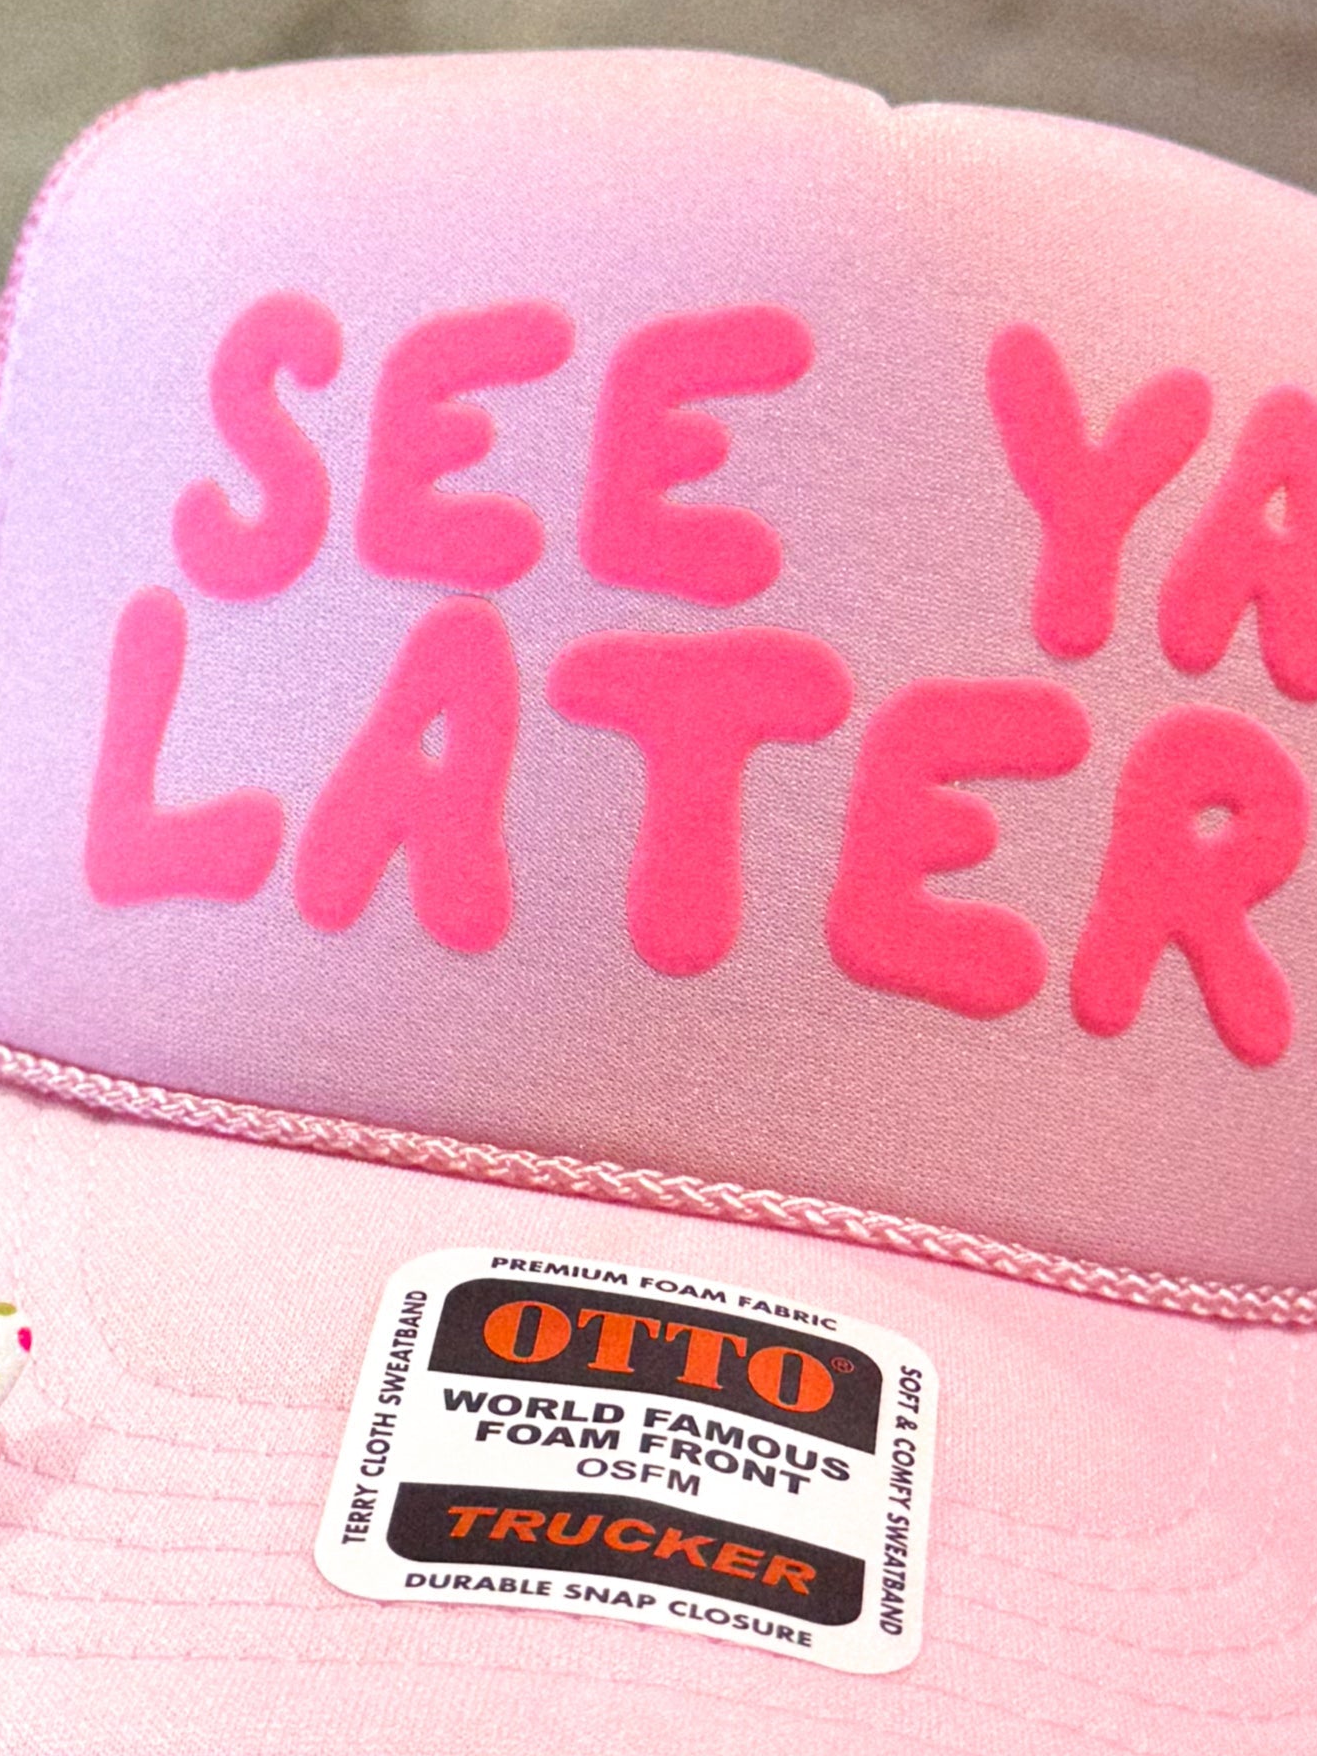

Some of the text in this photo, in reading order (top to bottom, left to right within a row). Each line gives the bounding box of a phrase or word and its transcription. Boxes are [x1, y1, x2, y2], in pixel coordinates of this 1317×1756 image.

[172, 291, 815, 609] SEE
[490, 1255, 839, 1332] PREMIUM FOAM FABRIC
[341, 1289, 429, 1545] TERRY CLOTH SWEATBAND
[442, 1387, 852, 1482] WORLD FAMOUS
[474, 1419, 812, 1497] FOAM FRONT
[575, 1457, 702, 1497] OSFM
[879, 1364, 923, 1637] SOFT & COMFY SWEATBAND
[446, 1505, 819, 1596] TRUCKER
[404, 1571, 814, 1649] DURABLE SNAP CLOSURE
